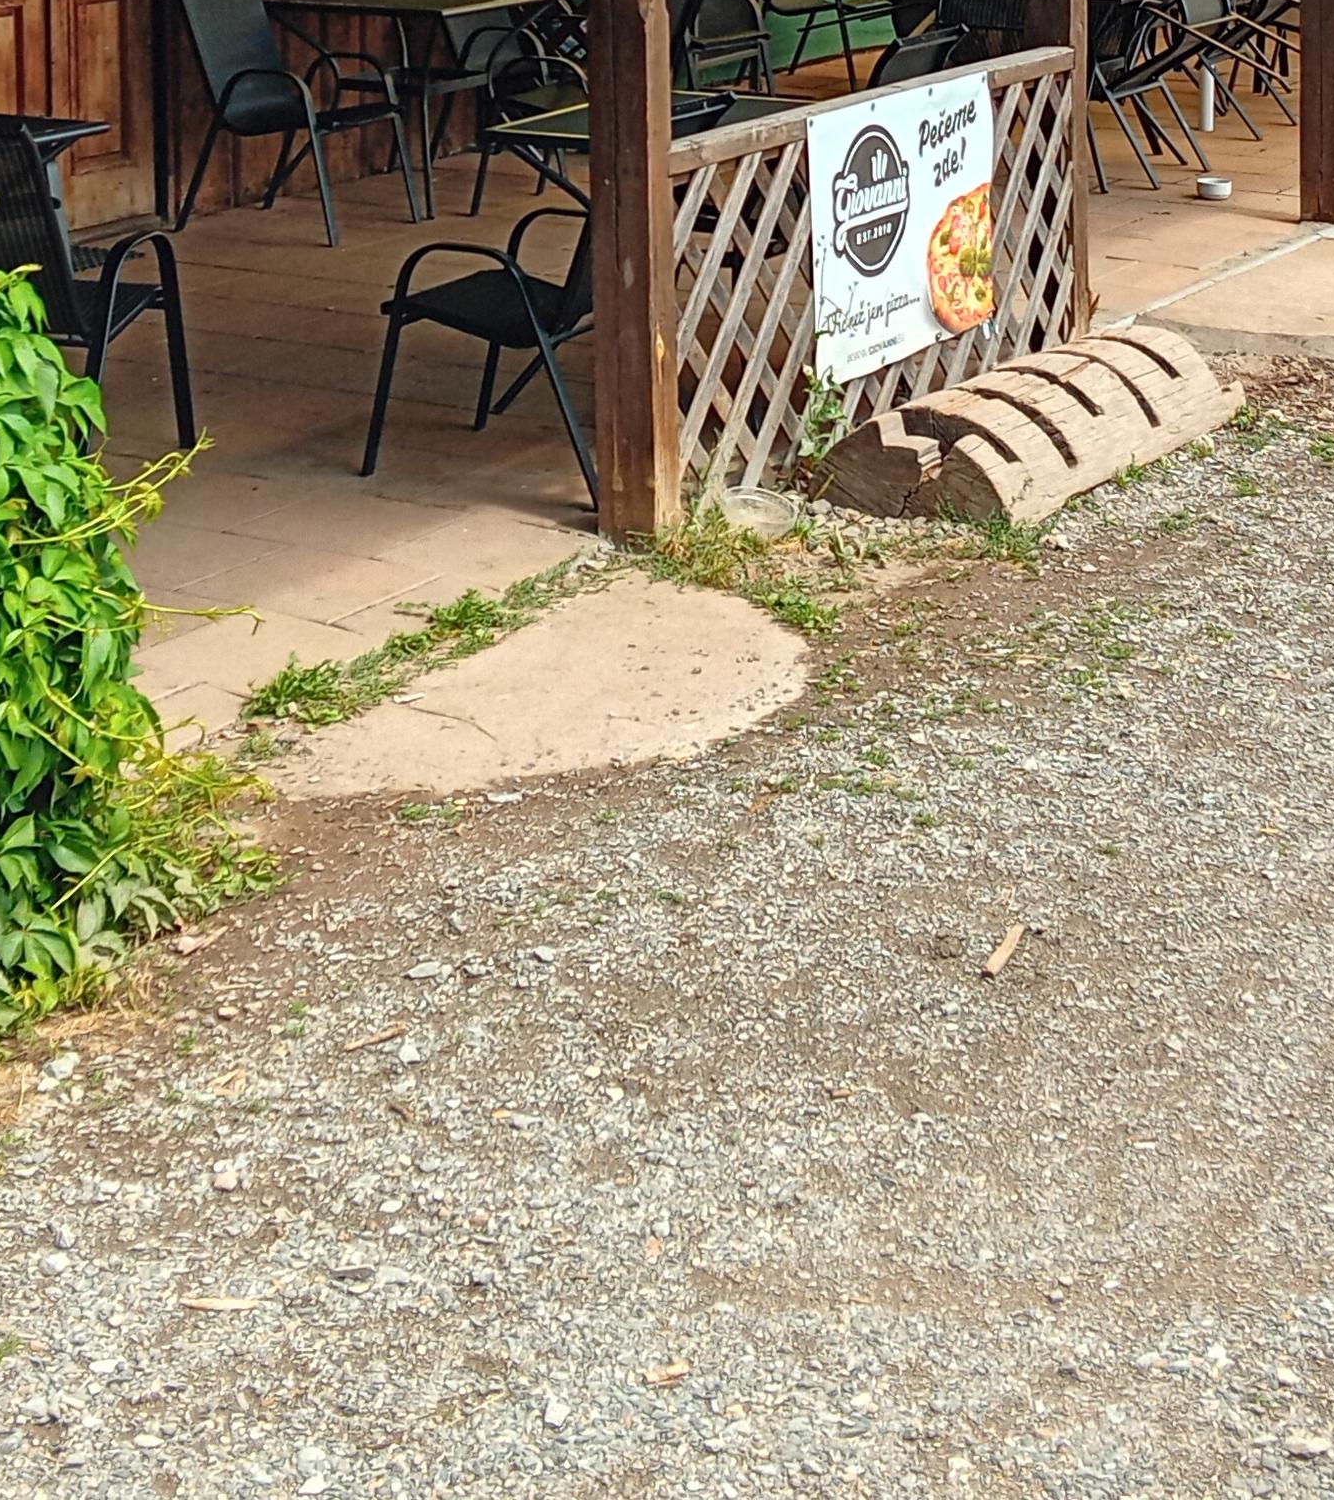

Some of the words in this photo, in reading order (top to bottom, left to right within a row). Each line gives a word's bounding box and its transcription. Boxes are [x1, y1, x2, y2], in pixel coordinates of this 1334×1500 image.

[918, 99, 977, 157] Pečeme
[933, 136, 967, 188] zde!
[834, 166, 909, 228] Giovanni
[865, 302, 884, 335] jen
